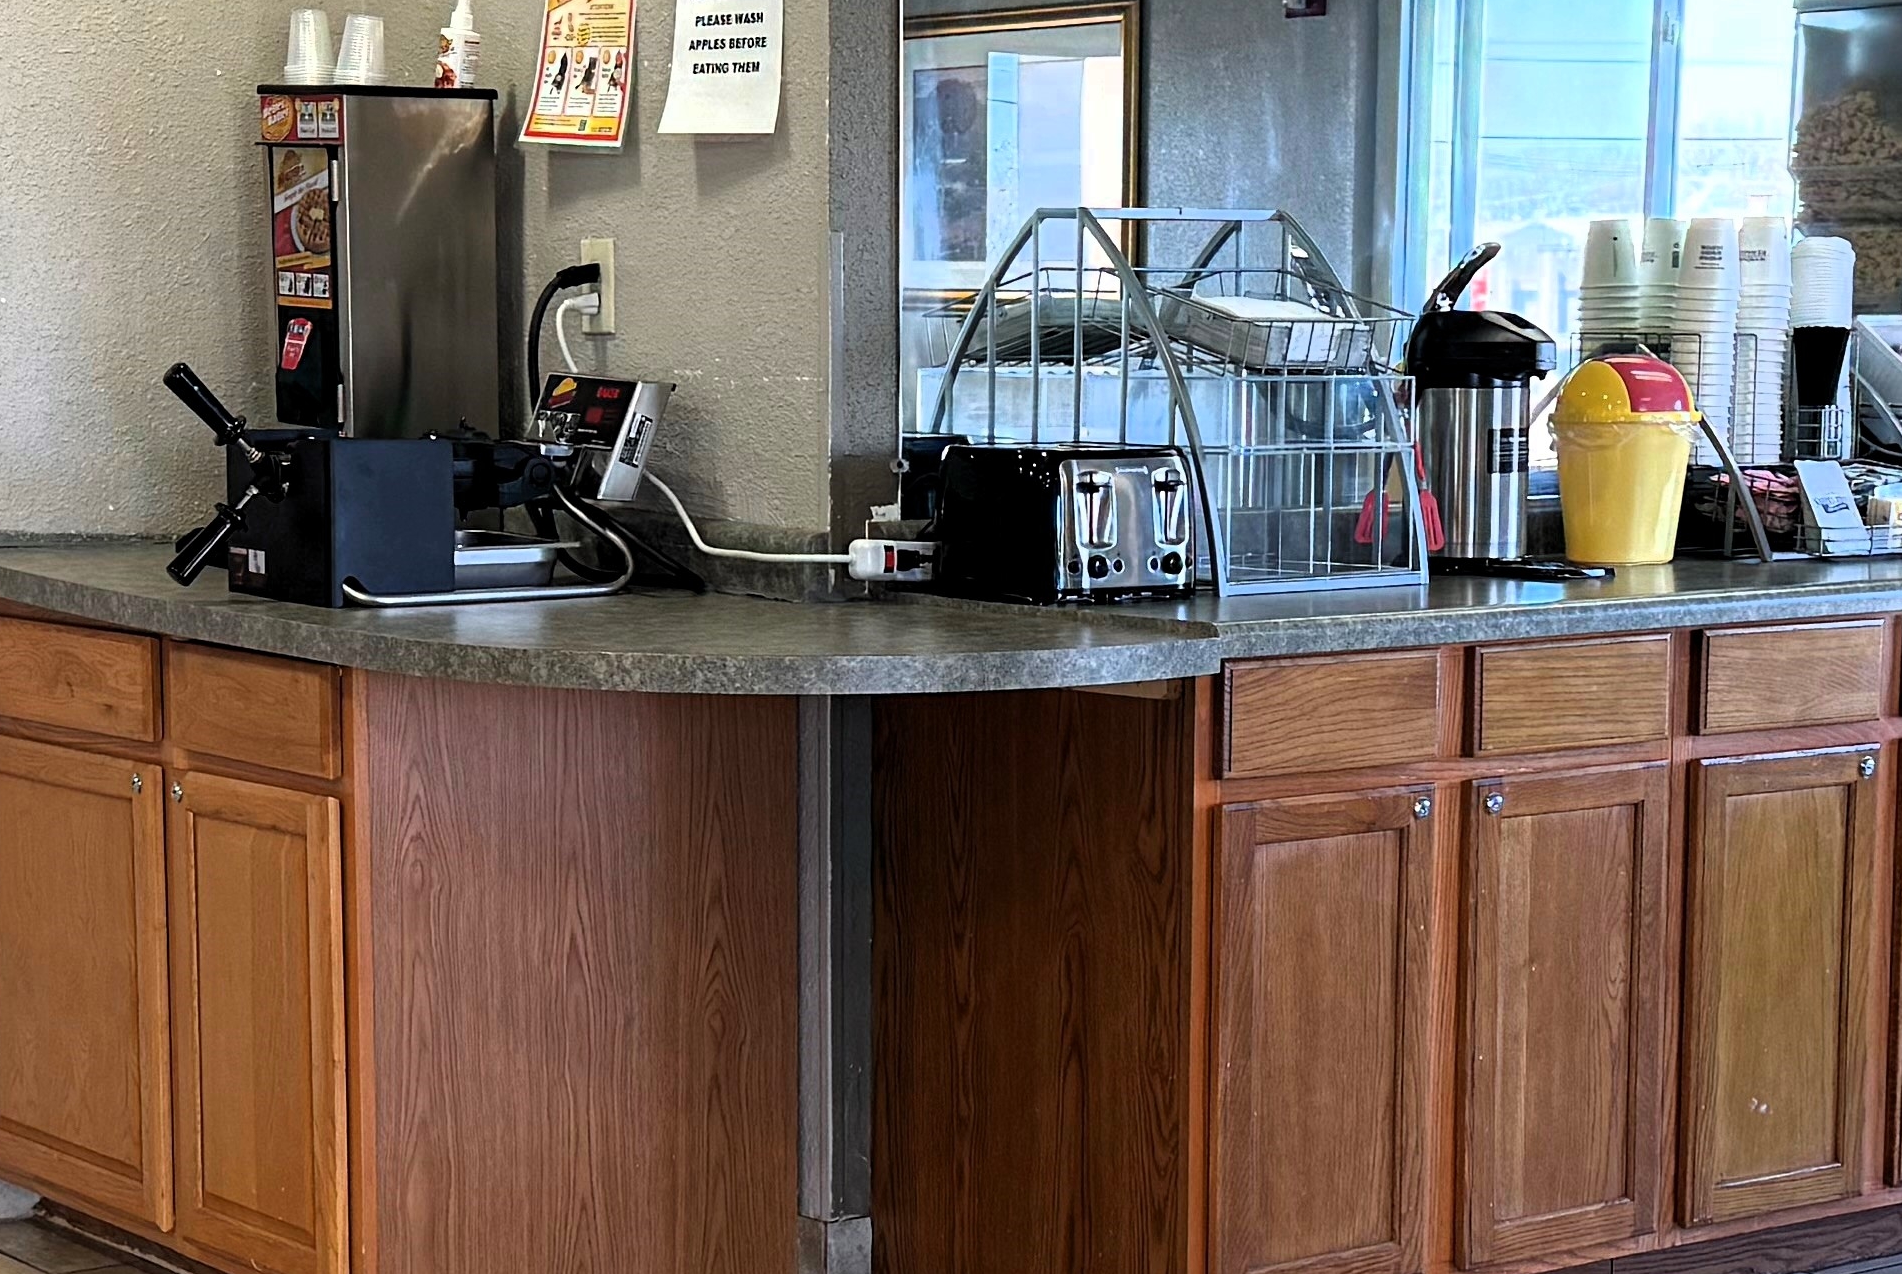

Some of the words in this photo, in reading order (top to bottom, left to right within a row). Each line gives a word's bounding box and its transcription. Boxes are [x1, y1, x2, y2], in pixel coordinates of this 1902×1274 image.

[695, 13, 733, 27] PLEASE
[734, 11, 764, 25] WASH
[688, 38, 726, 51] APPLES
[728, 36, 768, 50] BEFORE
[692, 62, 730, 75] EATING
[731, 61, 761, 74] THEM
